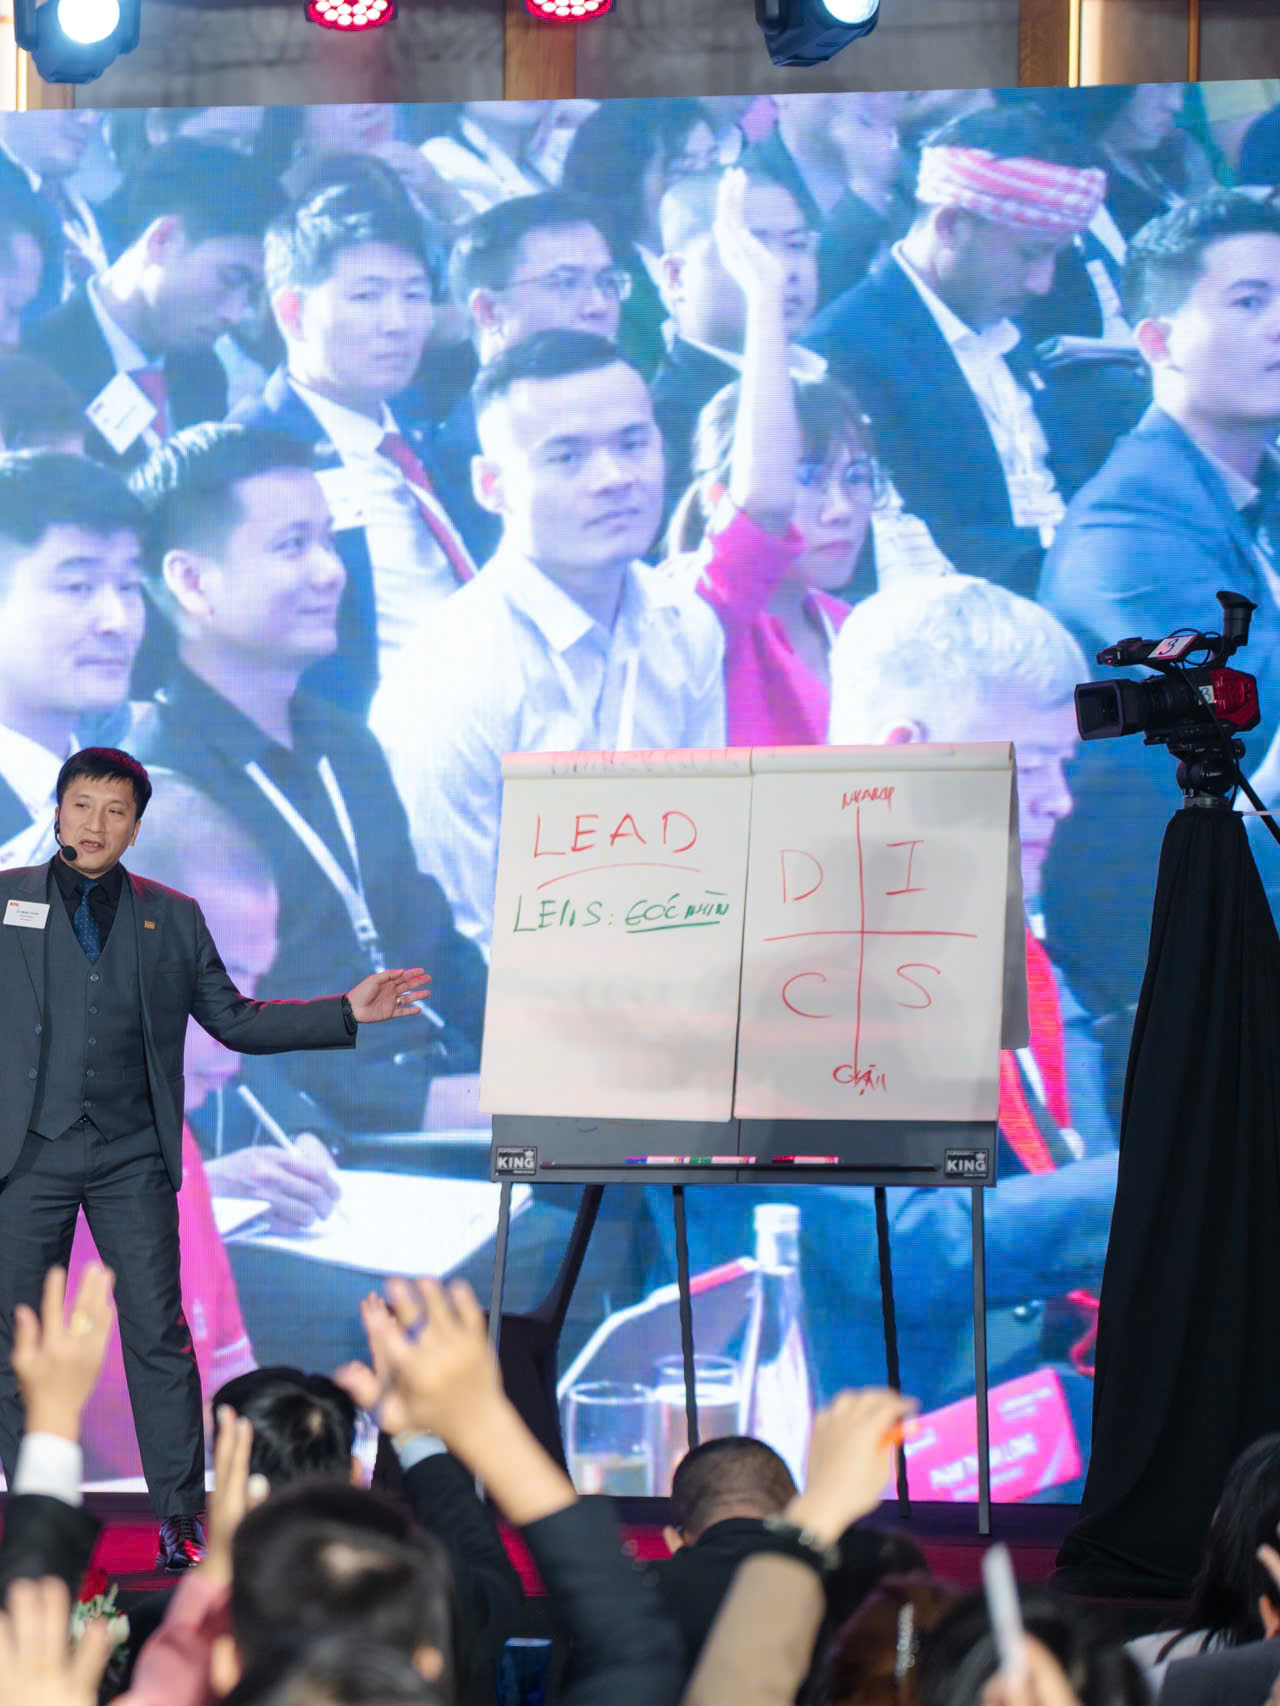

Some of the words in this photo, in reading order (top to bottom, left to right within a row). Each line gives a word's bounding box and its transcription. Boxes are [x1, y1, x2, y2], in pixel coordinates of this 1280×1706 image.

[532, 810, 698, 858] LEAD
[779, 848, 824, 904] D
[884, 839, 929, 897] I
[780, 970, 833, 1019] C
[896, 962, 941, 1010] S
[497, 1156, 535, 1169] KING
[947, 1159, 986, 1171] KING
